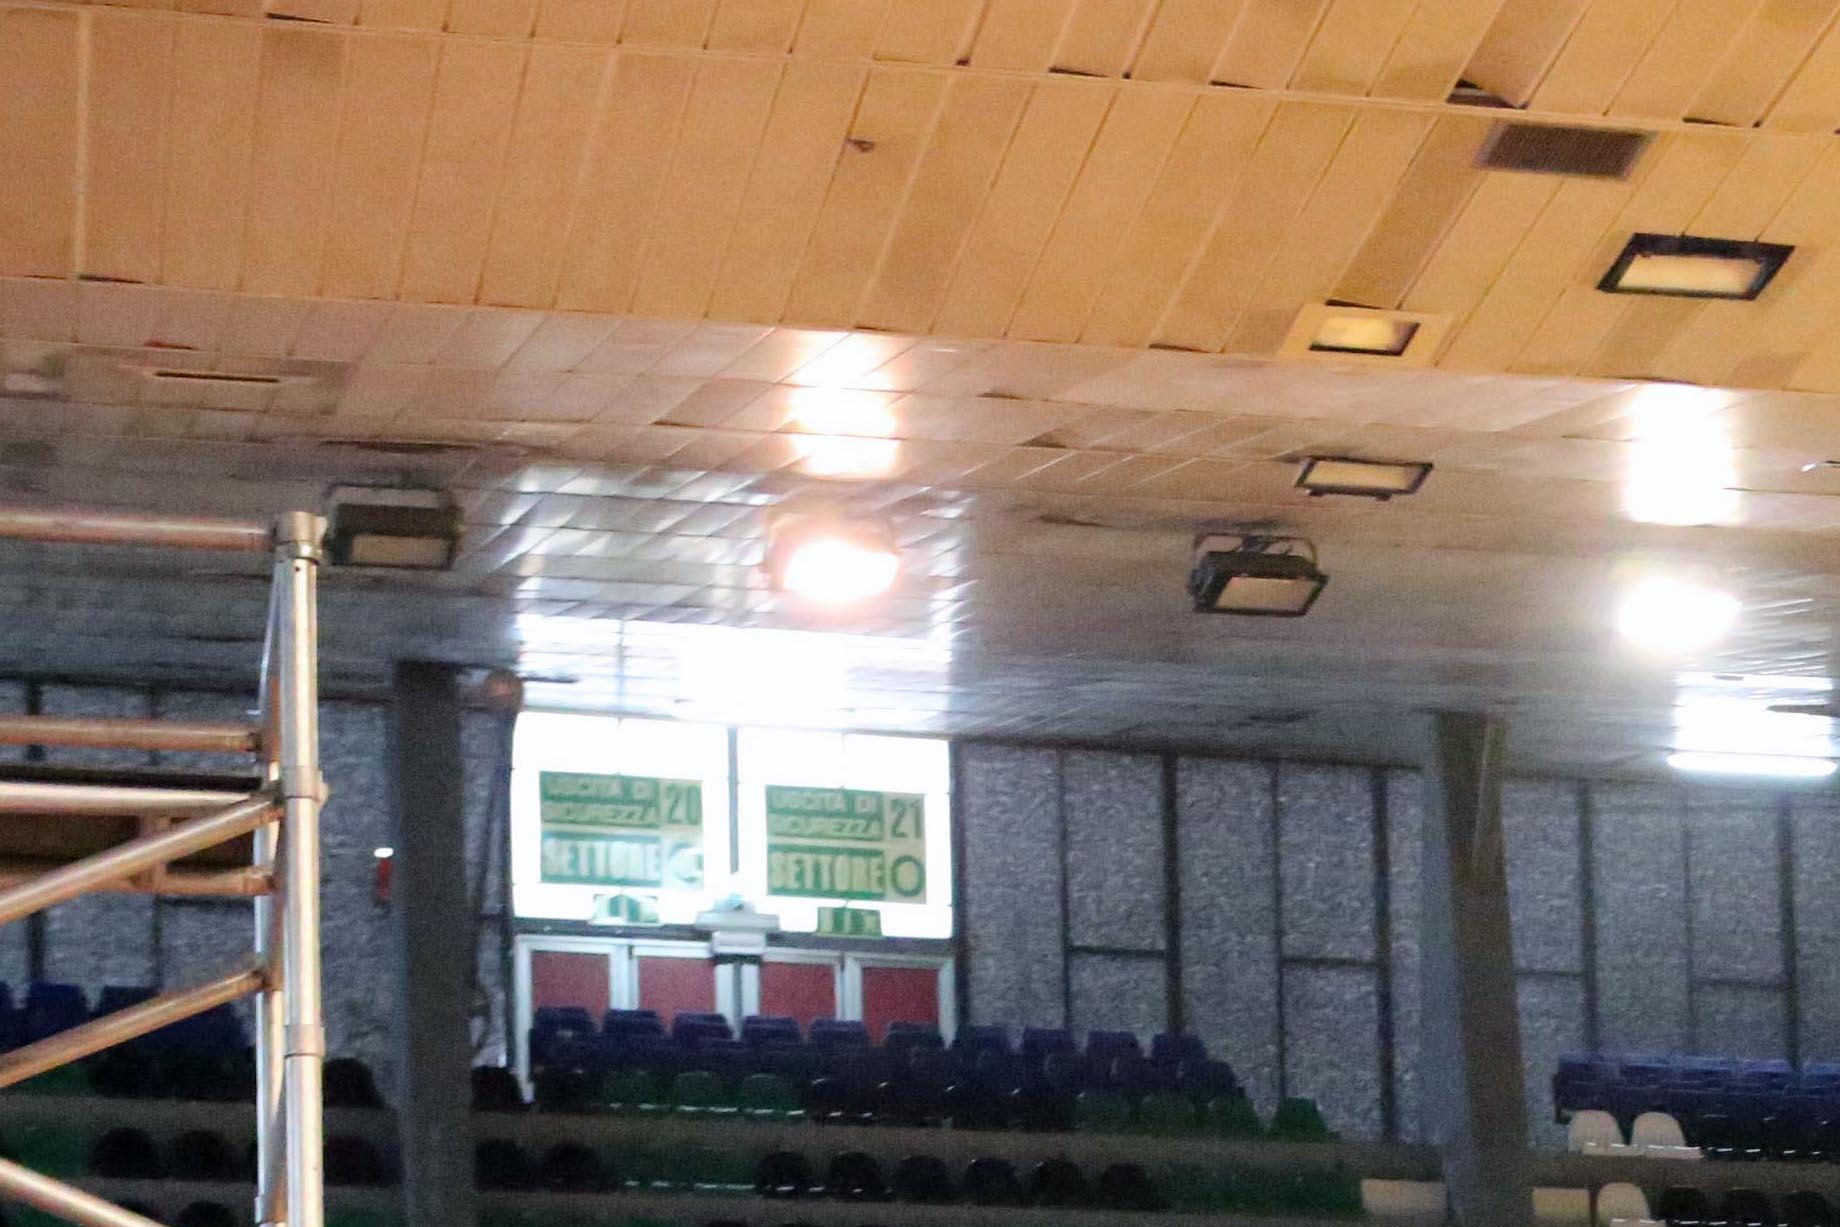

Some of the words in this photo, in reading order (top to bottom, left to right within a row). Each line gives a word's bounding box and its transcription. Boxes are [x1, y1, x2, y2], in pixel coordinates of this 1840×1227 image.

[545, 777, 623, 799] USCITA
[667, 782, 702, 825] 20
[772, 790, 846, 812] USCITA
[543, 802, 660, 827] SICUREZZA
[768, 815, 884, 839] SICUREZZA
[890, 798, 922, 839] 21
[543, 839, 661, 880] SETTORE
[770, 852, 886, 892] SETTORE
